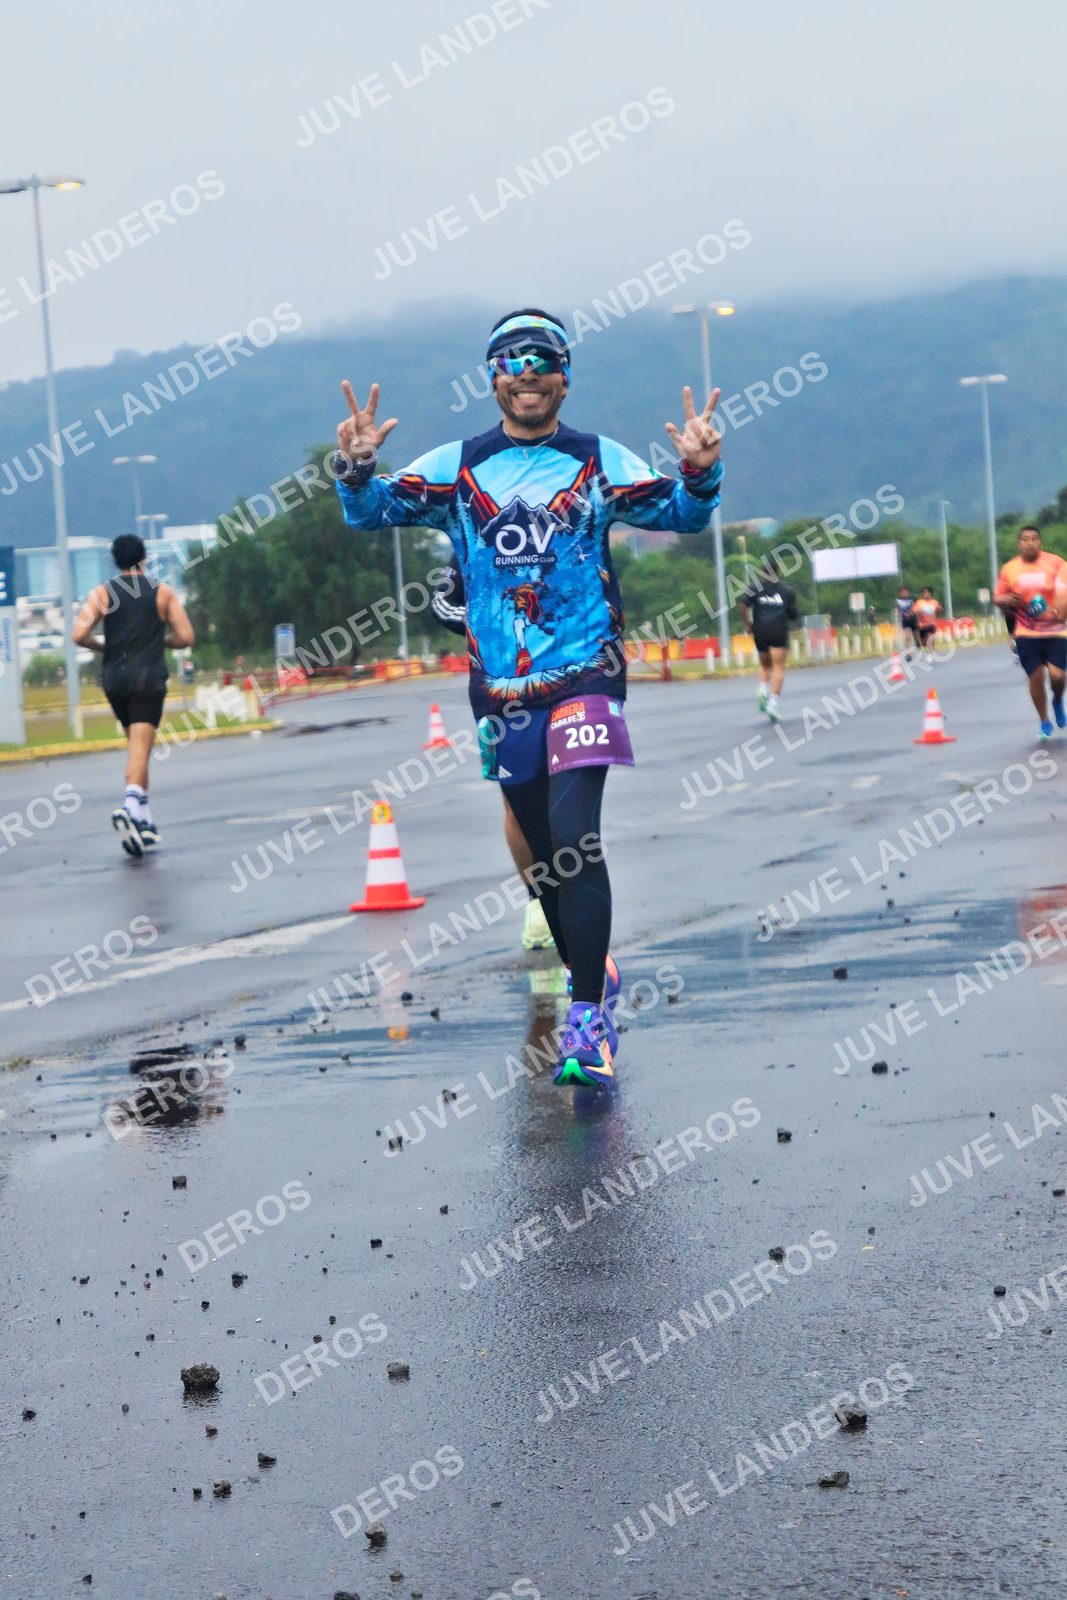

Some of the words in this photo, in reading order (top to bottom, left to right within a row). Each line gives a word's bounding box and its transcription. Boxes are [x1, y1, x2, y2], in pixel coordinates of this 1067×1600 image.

[495, 554, 539, 566] RUNNING
[551, 701, 586, 722] CARRERA
[565, 723, 610, 749] 202
